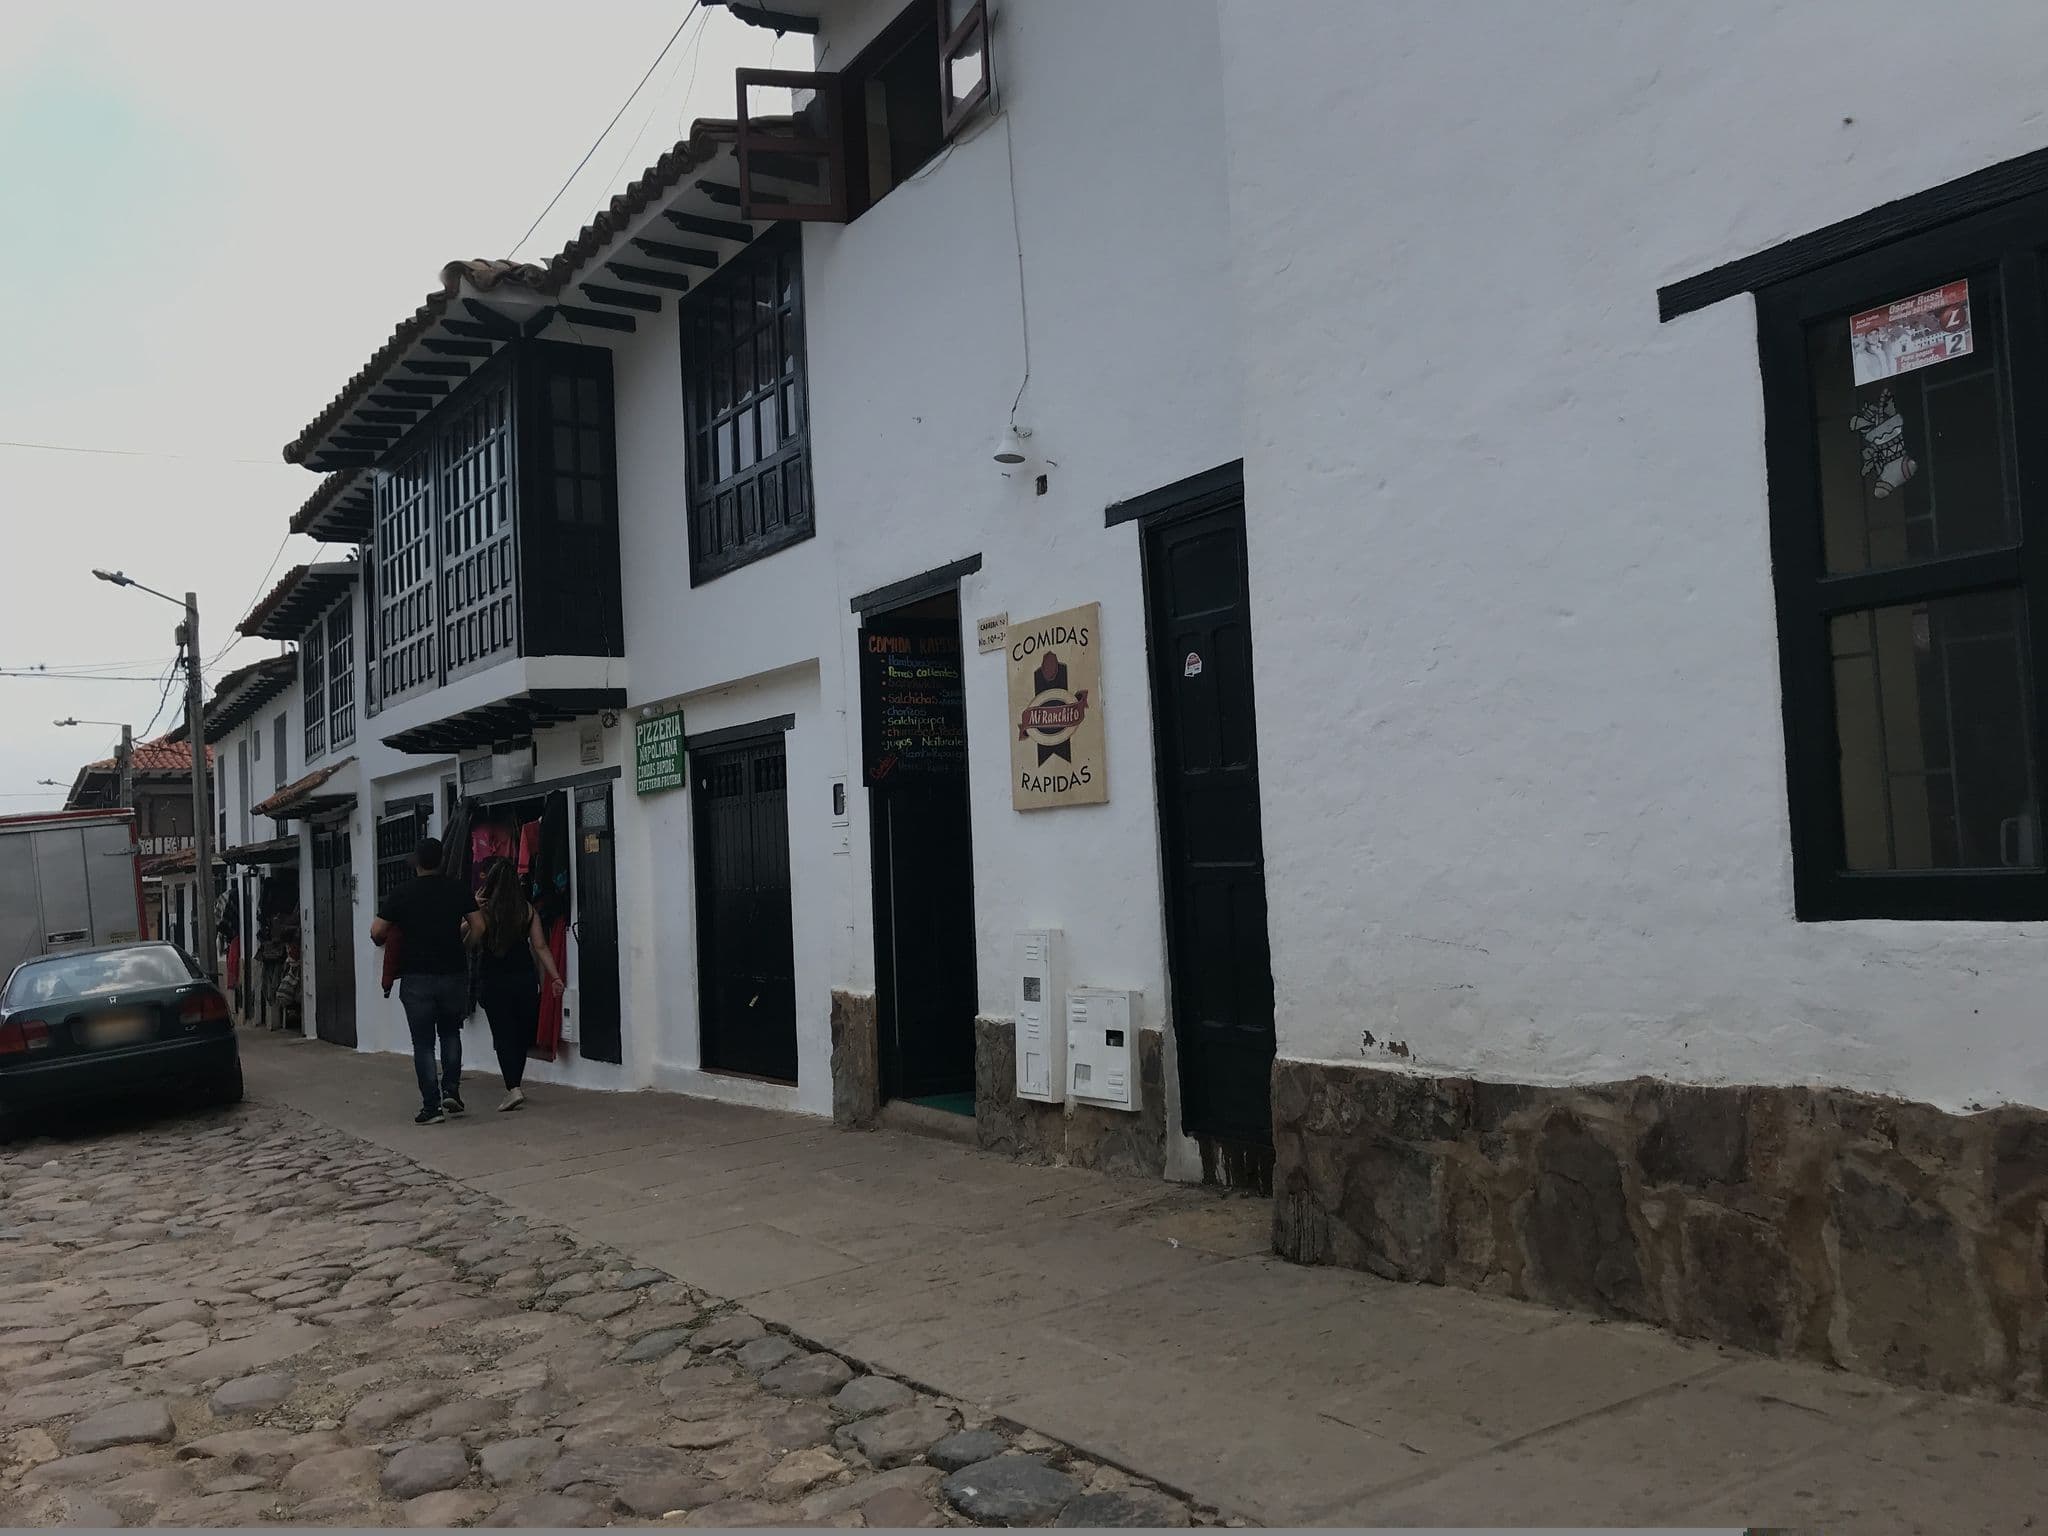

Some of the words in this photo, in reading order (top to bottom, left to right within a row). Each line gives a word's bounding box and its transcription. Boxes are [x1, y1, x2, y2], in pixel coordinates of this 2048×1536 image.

[1889, 299, 1915, 314] Oscar
[1946, 309, 1960, 328] L
[1950, 334, 1963, 353] 2
[1012, 626, 1089, 661] COMIDAS
[636, 714, 682, 747] PIZZERIA
[639, 739, 678, 765] NAPOLITANA
[1021, 765, 1091, 793] RAPIDAS
